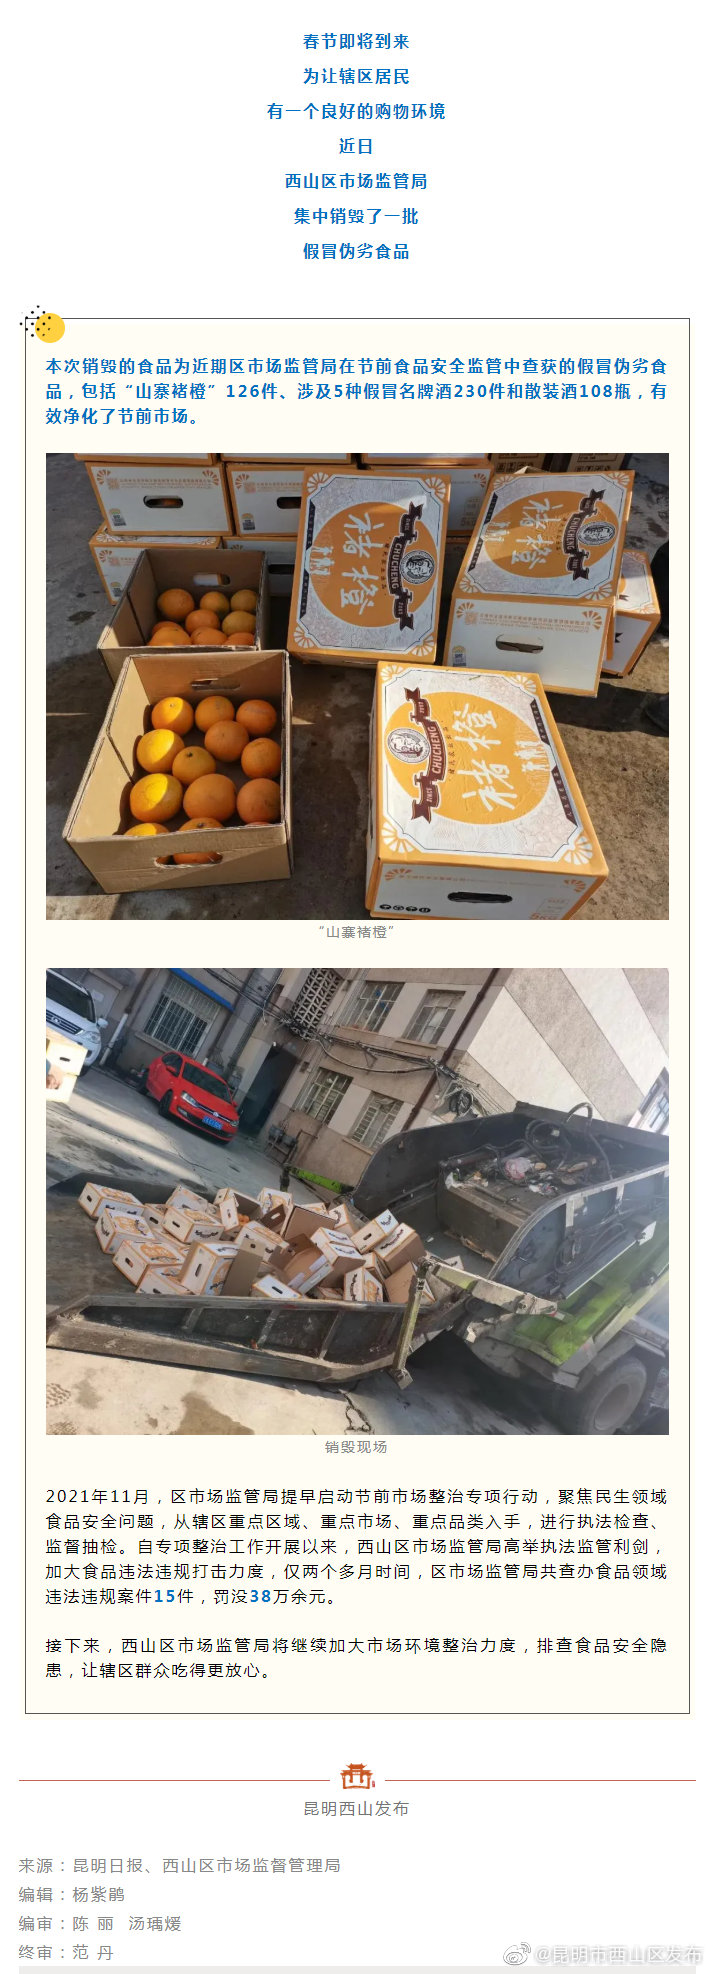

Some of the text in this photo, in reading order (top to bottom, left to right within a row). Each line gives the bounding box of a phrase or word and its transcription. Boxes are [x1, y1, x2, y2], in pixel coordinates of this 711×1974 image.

[566, 517, 581, 551] CHUCHENG
[391, 543, 403, 590] CHUCHENG
[427, 726, 442, 774] CHUCHENG
[452, 703, 518, 812] 褚橙
